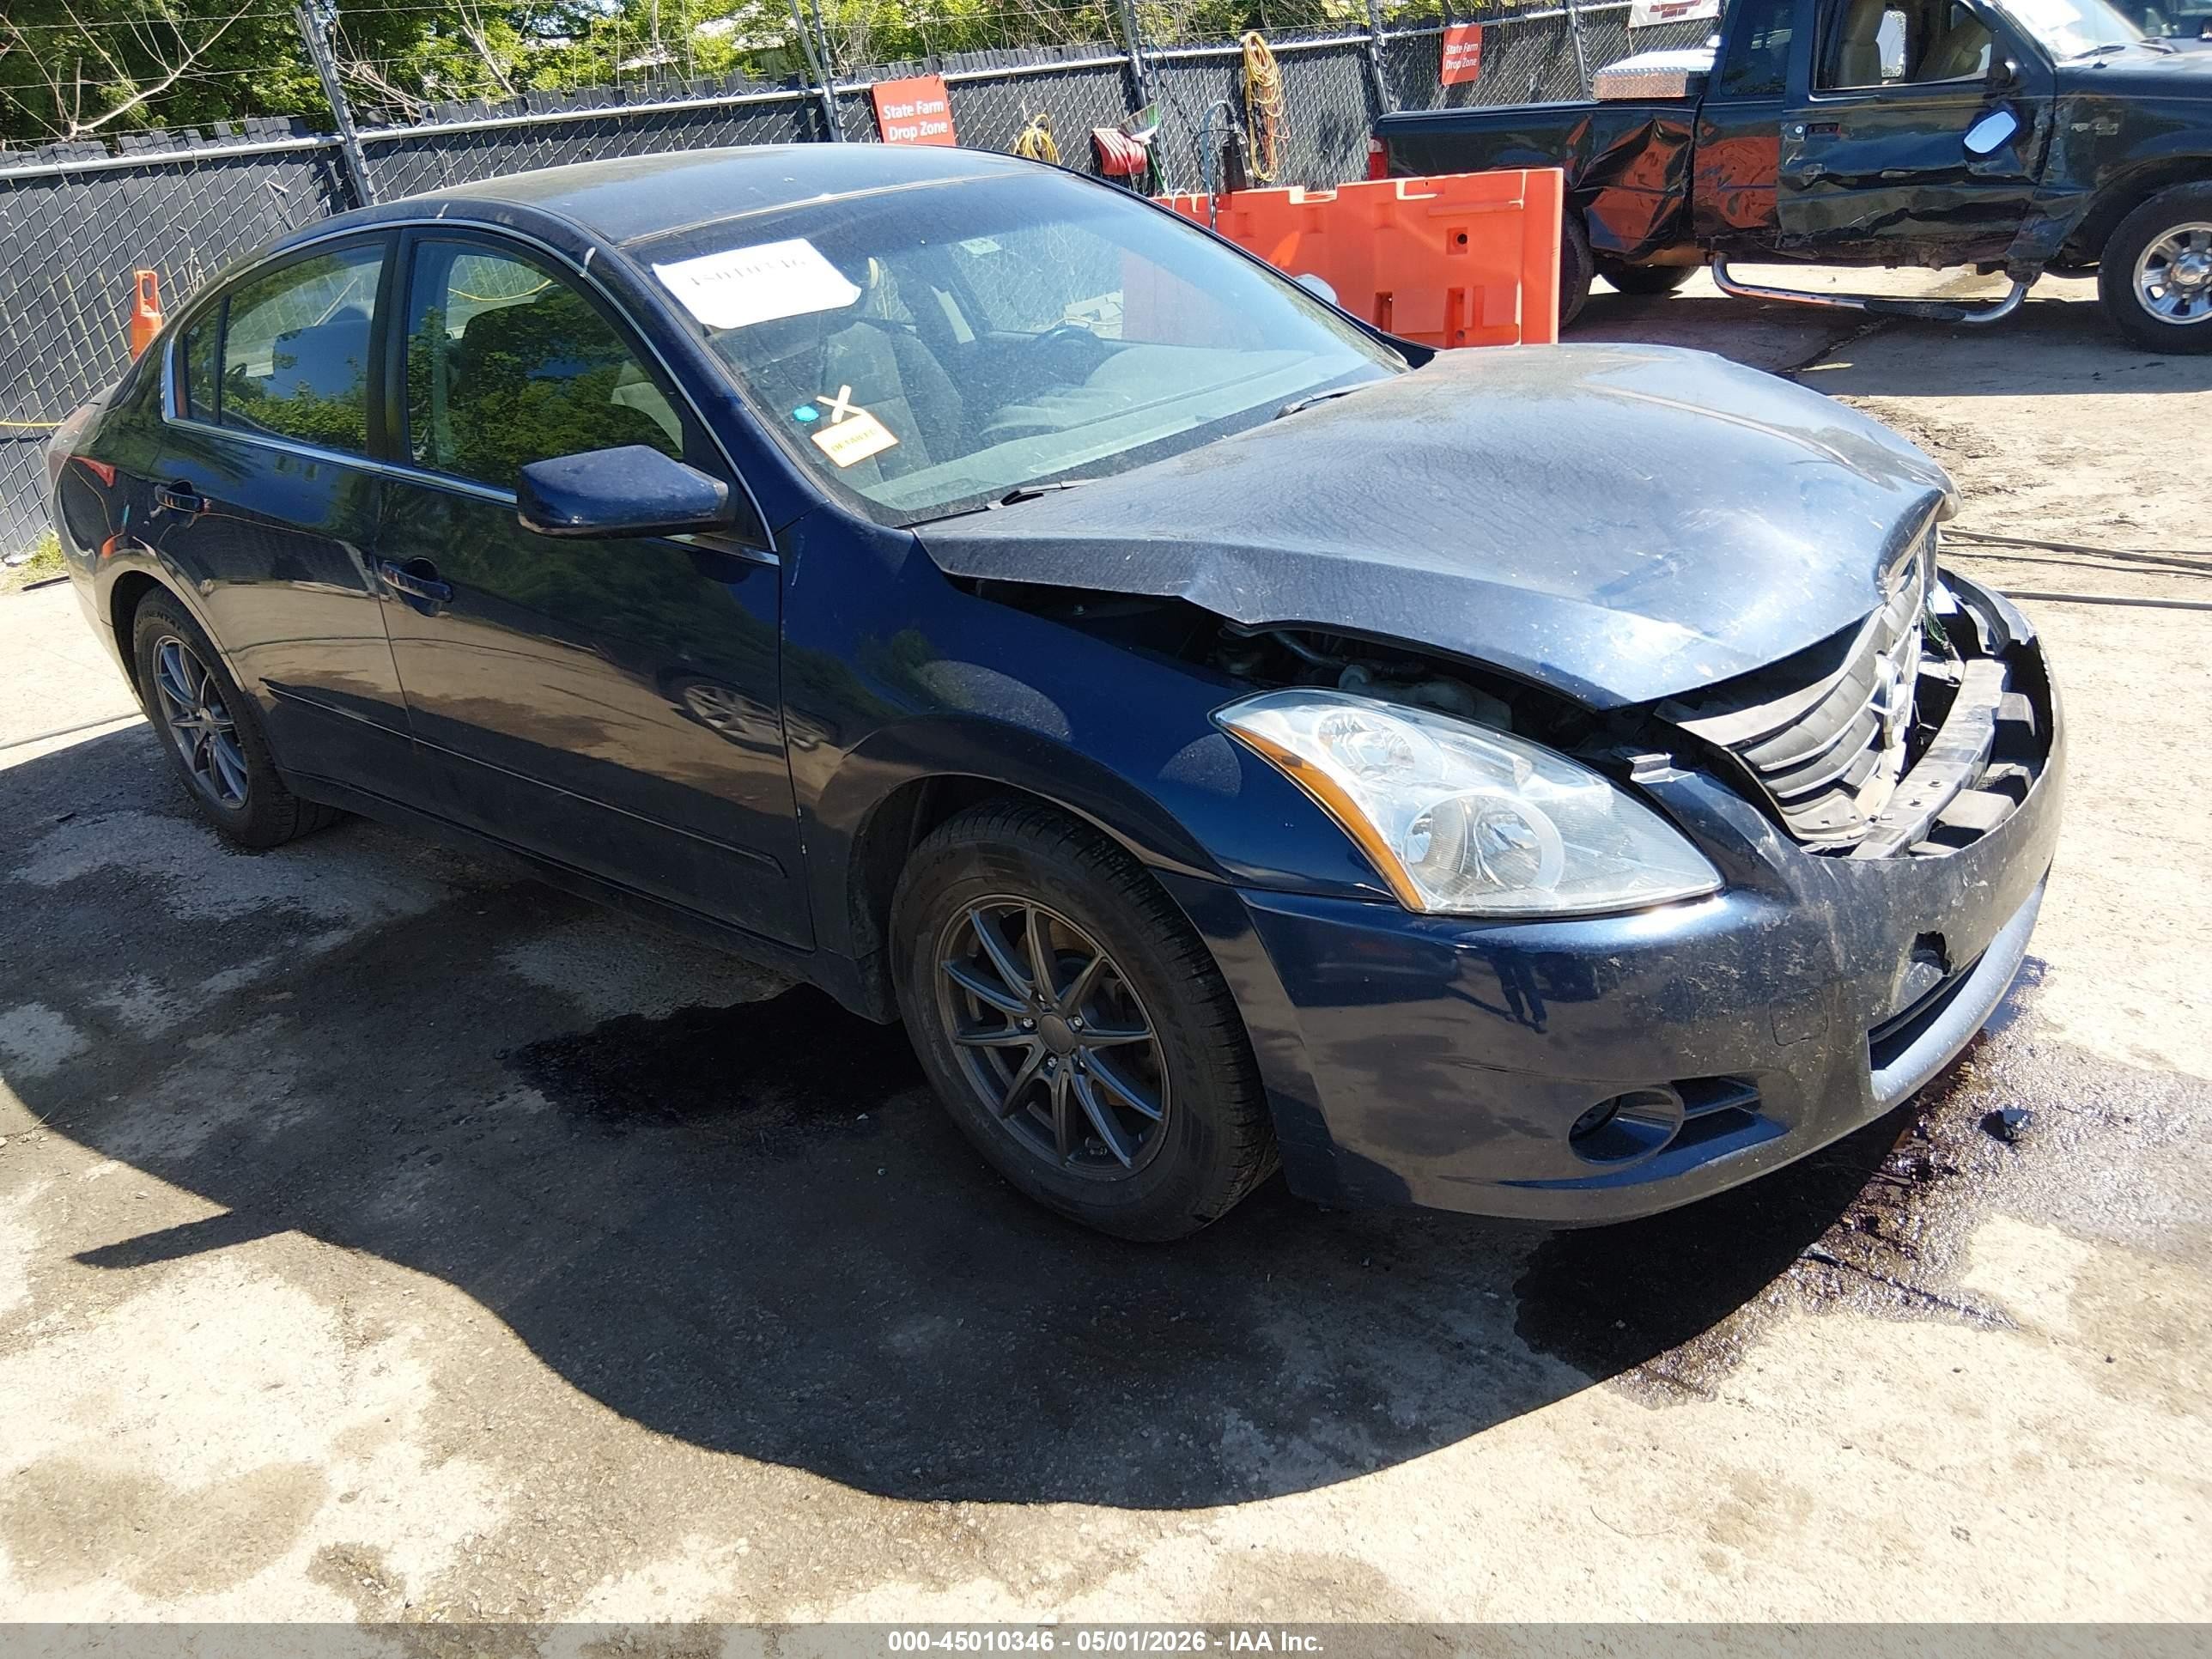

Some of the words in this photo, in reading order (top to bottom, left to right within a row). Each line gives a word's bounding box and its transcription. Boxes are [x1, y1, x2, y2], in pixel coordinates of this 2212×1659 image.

[1445, 44, 1462, 56] State
[1463, 42, 1478, 52] Farm
[1445, 59, 1462, 70] Drop
[1462, 58, 1478, 68] Zone
[883, 103, 915, 120] State
[915, 100, 944, 115] Farm
[889, 125, 917, 142] Drop
[920, 121, 948, 137] Zone
